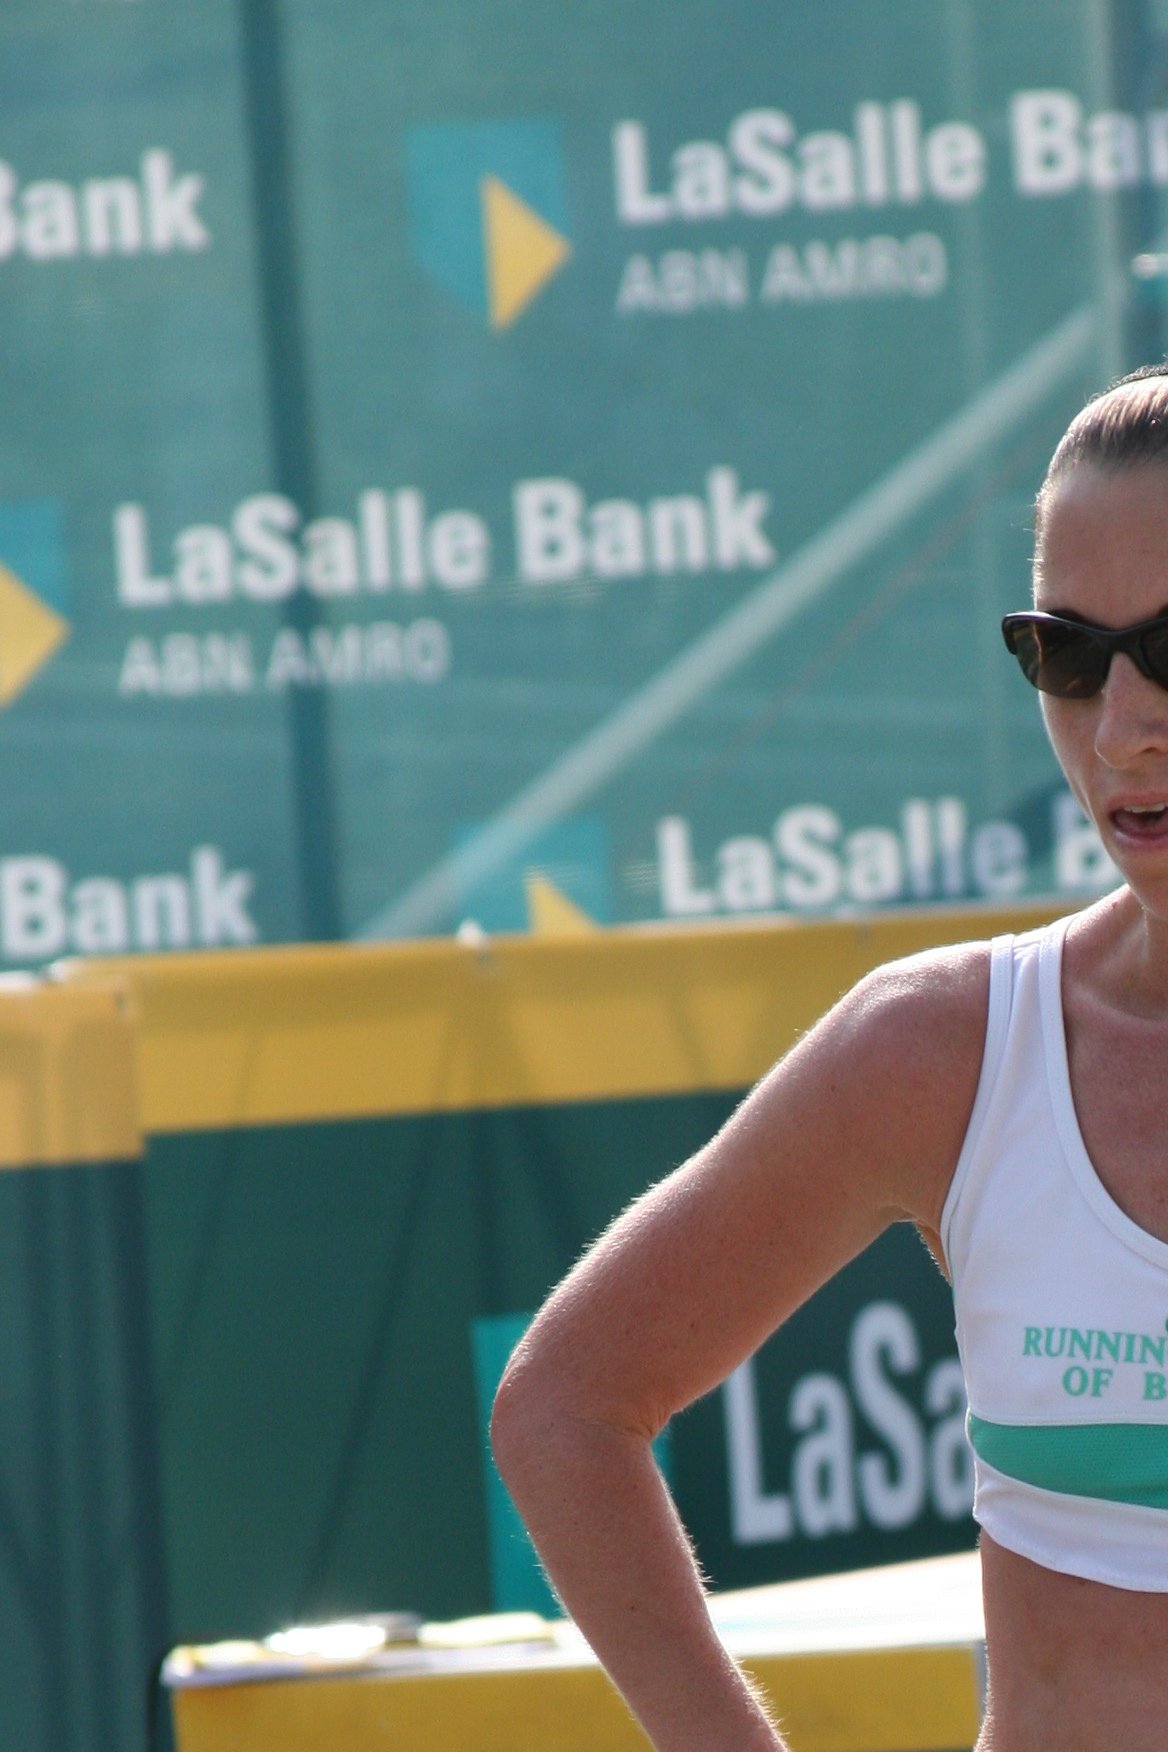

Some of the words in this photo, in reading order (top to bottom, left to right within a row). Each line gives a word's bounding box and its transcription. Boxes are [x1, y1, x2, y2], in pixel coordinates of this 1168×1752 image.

[0, 147, 208, 262] ank
[612, 98, 985, 224] LaSalle
[617, 248, 748, 312] ABN
[760, 232, 948, 302] AMRO
[113, 488, 490, 607] LaSalle
[512, 466, 775, 583] Bank
[118, 635, 258, 697] ABN
[265, 617, 451, 689] AMRO
[0, 845, 258, 960] Bank
[656, 796, 1028, 916] LaSalle
[1062, 1366, 1114, 1398] OF
